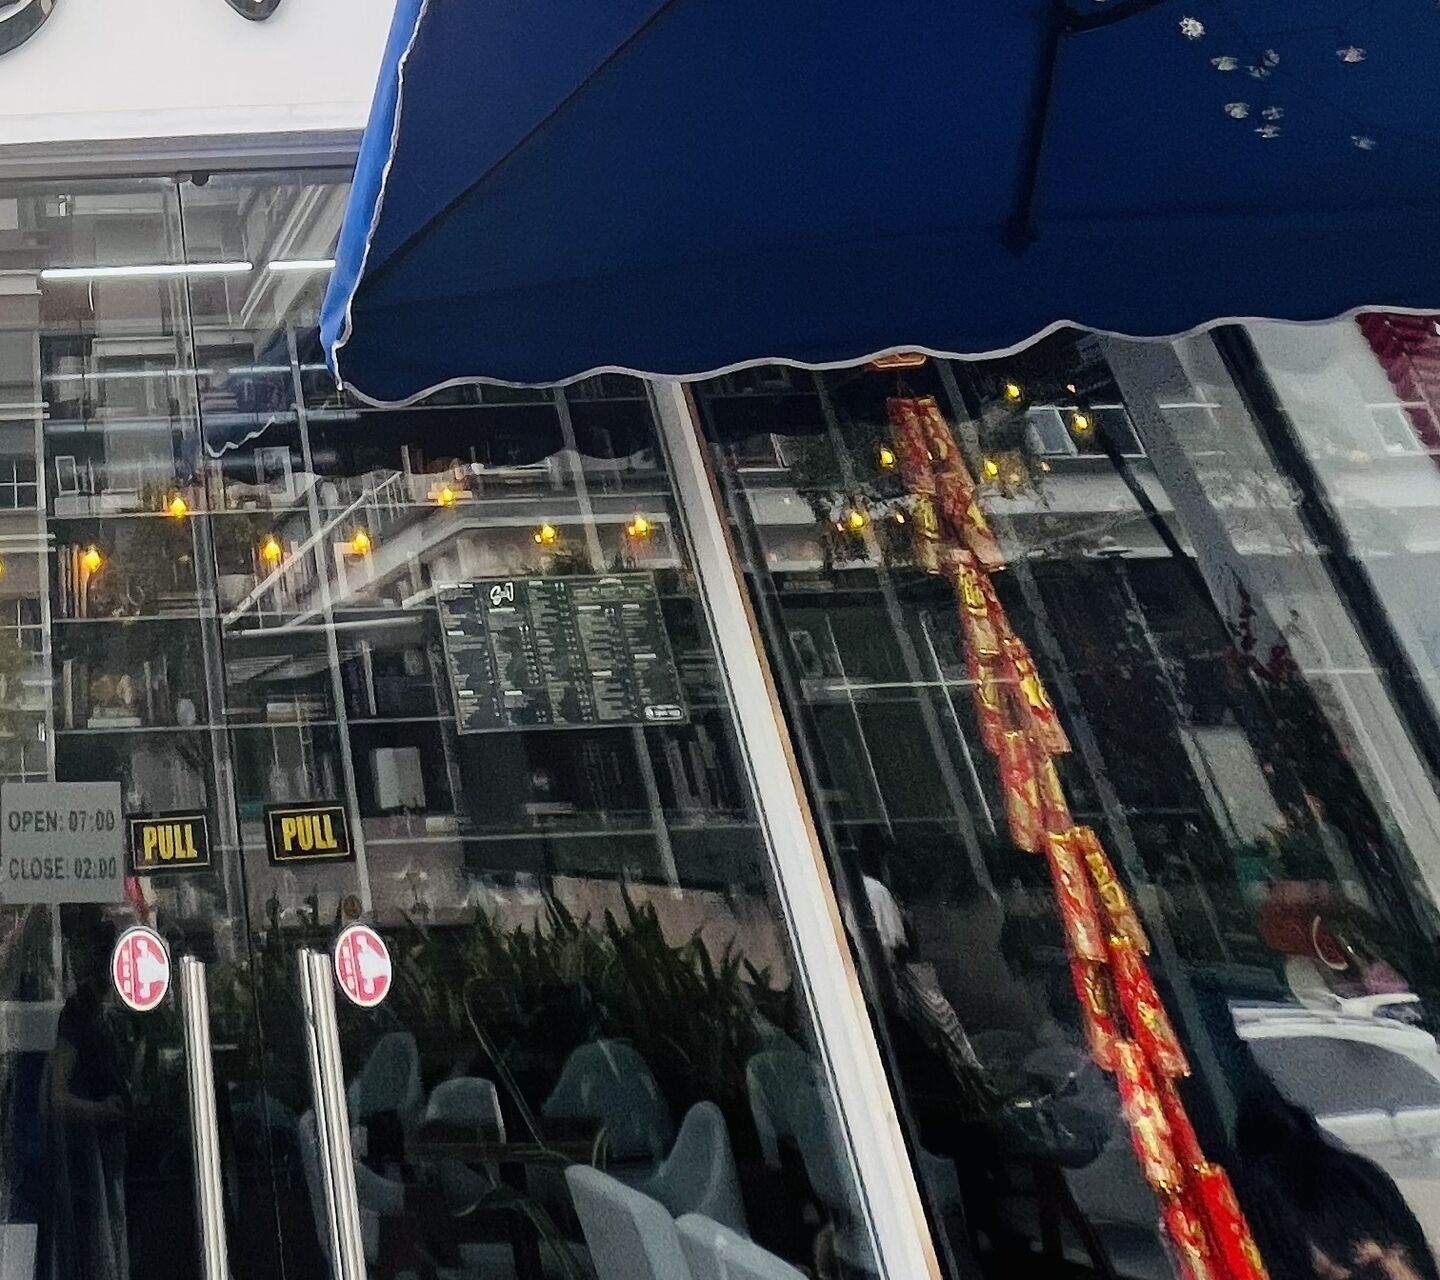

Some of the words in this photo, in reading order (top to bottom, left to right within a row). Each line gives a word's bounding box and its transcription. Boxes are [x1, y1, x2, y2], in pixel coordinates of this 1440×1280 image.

[68, 808, 115, 833] 07:00
[282, 814, 338, 851] PULL
[143, 823, 198, 861] PULL
